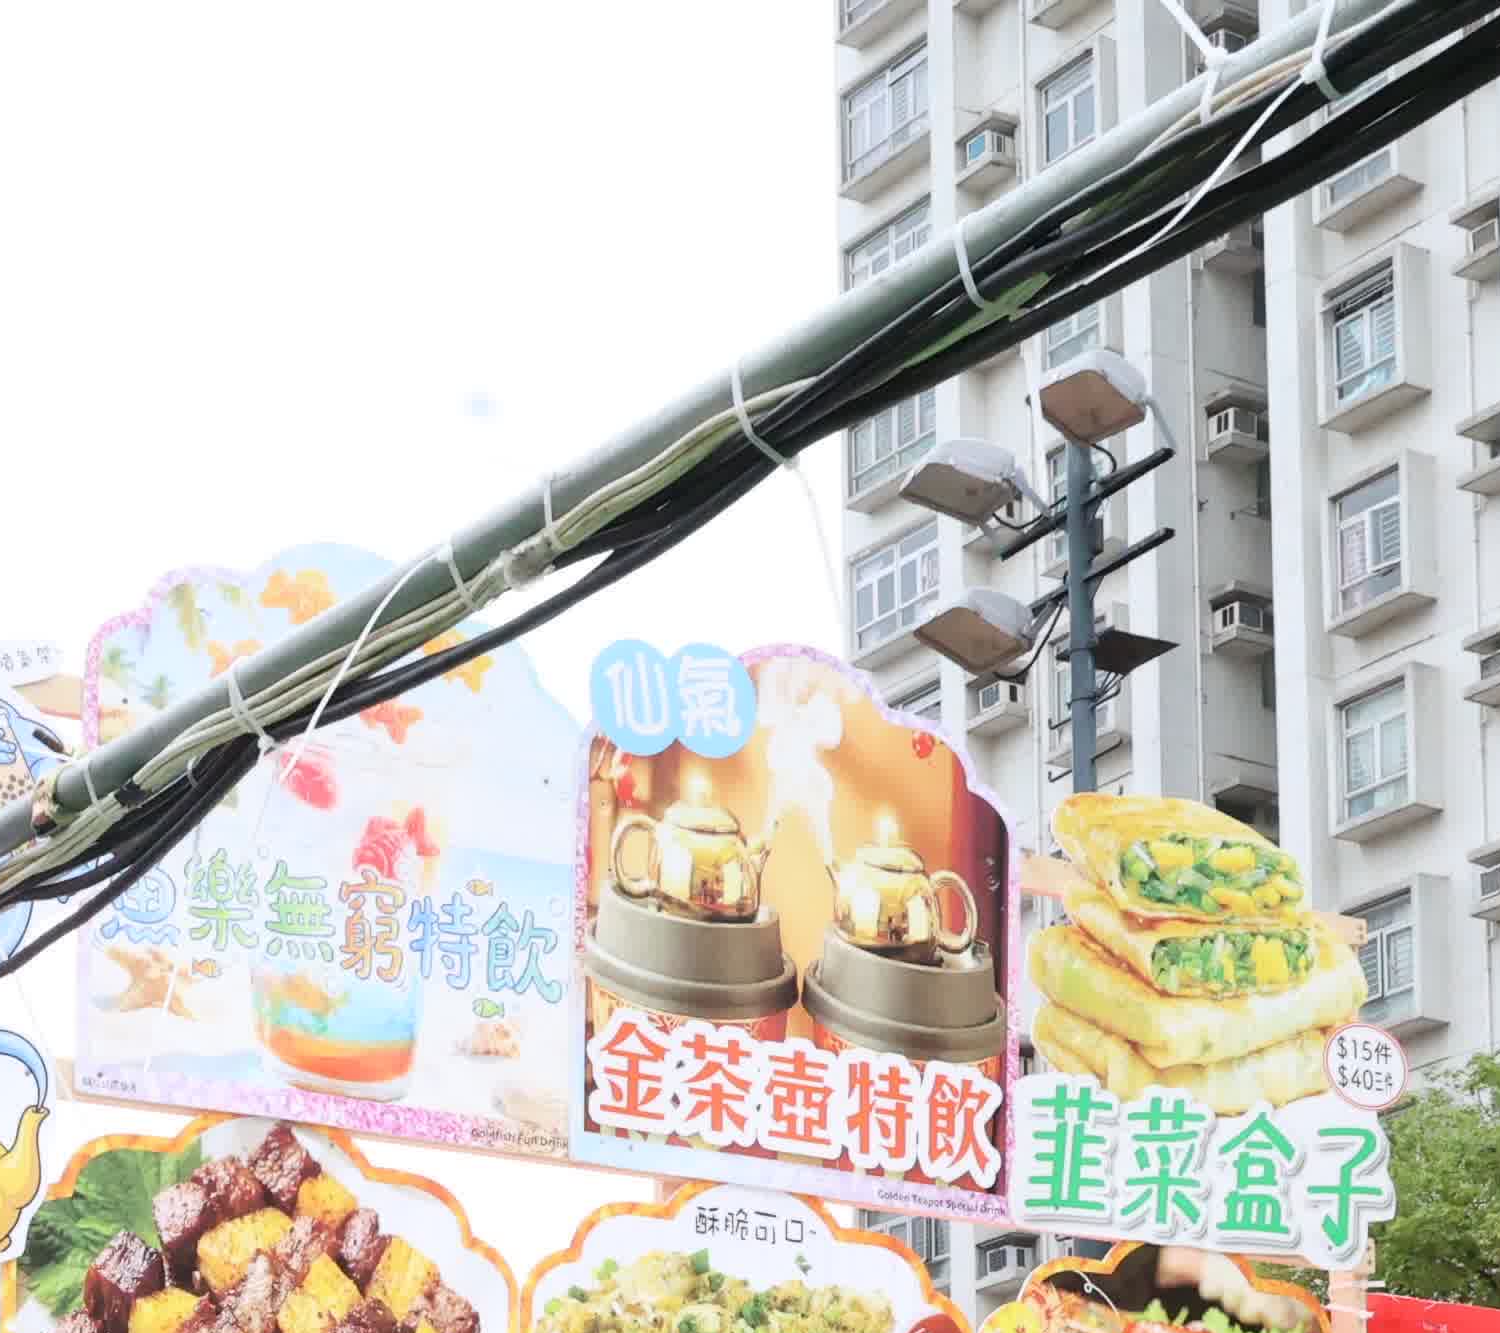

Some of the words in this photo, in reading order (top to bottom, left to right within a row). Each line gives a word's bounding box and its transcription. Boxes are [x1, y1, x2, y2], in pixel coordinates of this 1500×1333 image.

[603, 645, 742, 740] 仙氣
[99, 850, 563, 1004] 魚樂無窮特飲
[1337, 1034, 1392, 1063] $15件
[1338, 1064, 1396, 1094] $40三件
[599, 1020, 997, 1179] 金茶壺特飲
[470, 1127, 516, 1143] Goldfish
[1029, 1083, 1387, 1246] 韭菜盒子
[878, 1189, 911, 1203] Golden
[980, 1202, 1006, 1215] Drink
